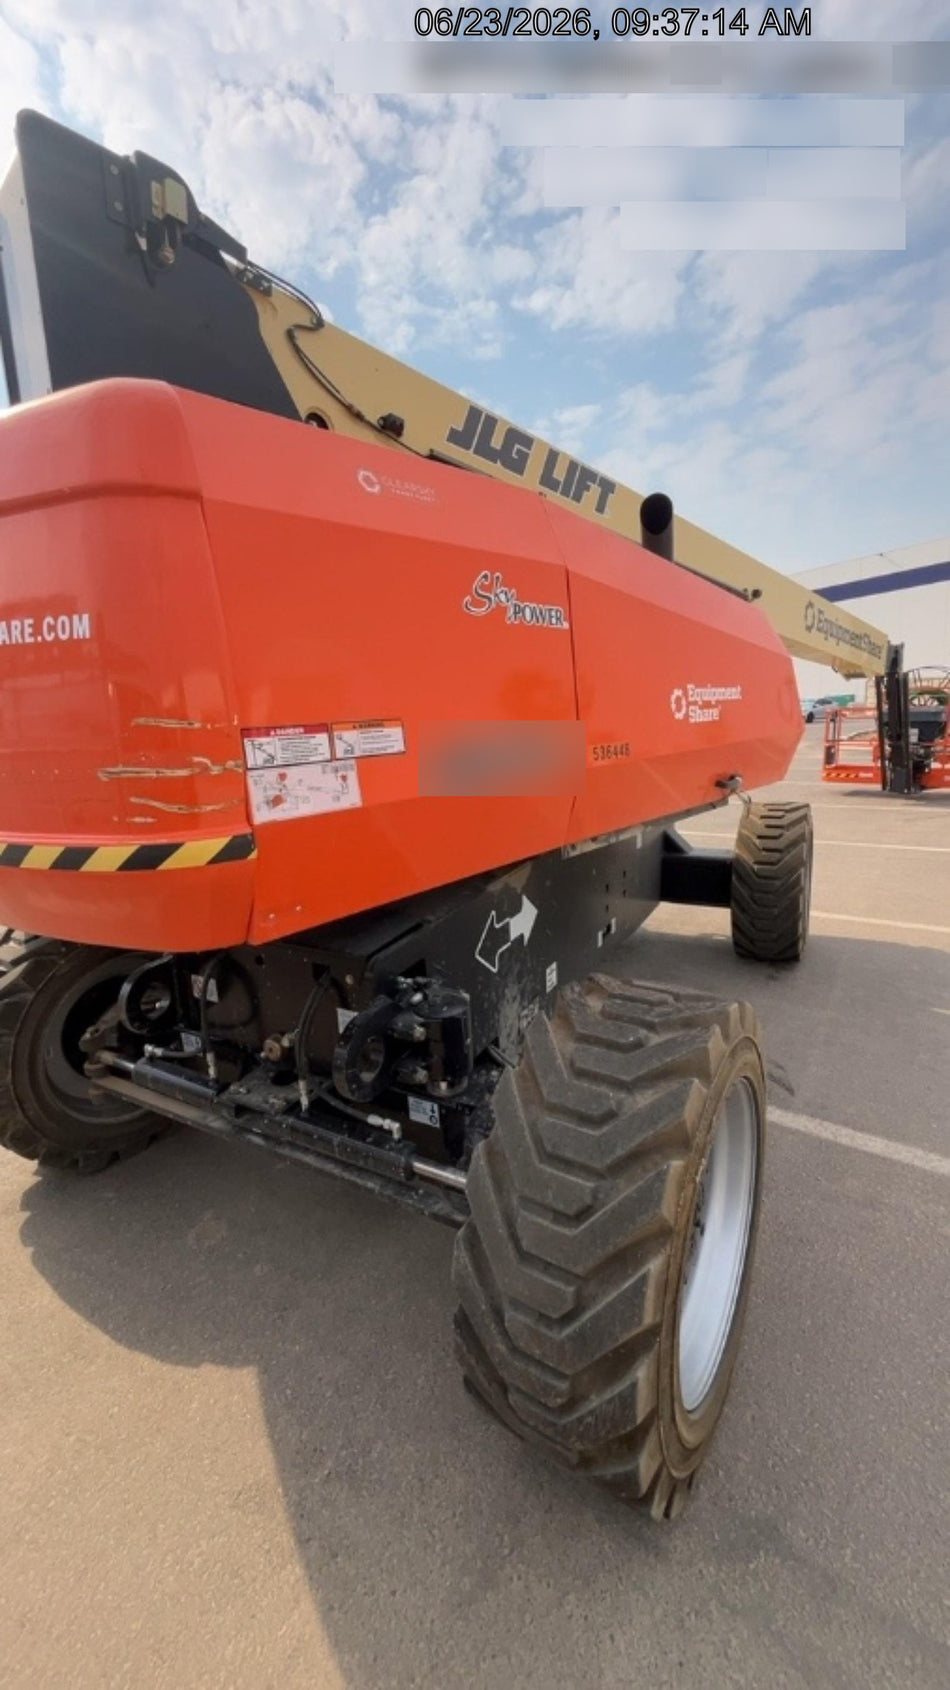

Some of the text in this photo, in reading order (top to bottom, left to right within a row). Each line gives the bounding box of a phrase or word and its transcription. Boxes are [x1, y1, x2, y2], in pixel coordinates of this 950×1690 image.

[445, 404, 617, 515] JLG LIFT
[512, 601, 565, 629] POWER
[687, 683, 742, 705] Equipment
[688, 705, 720, 723] Share
